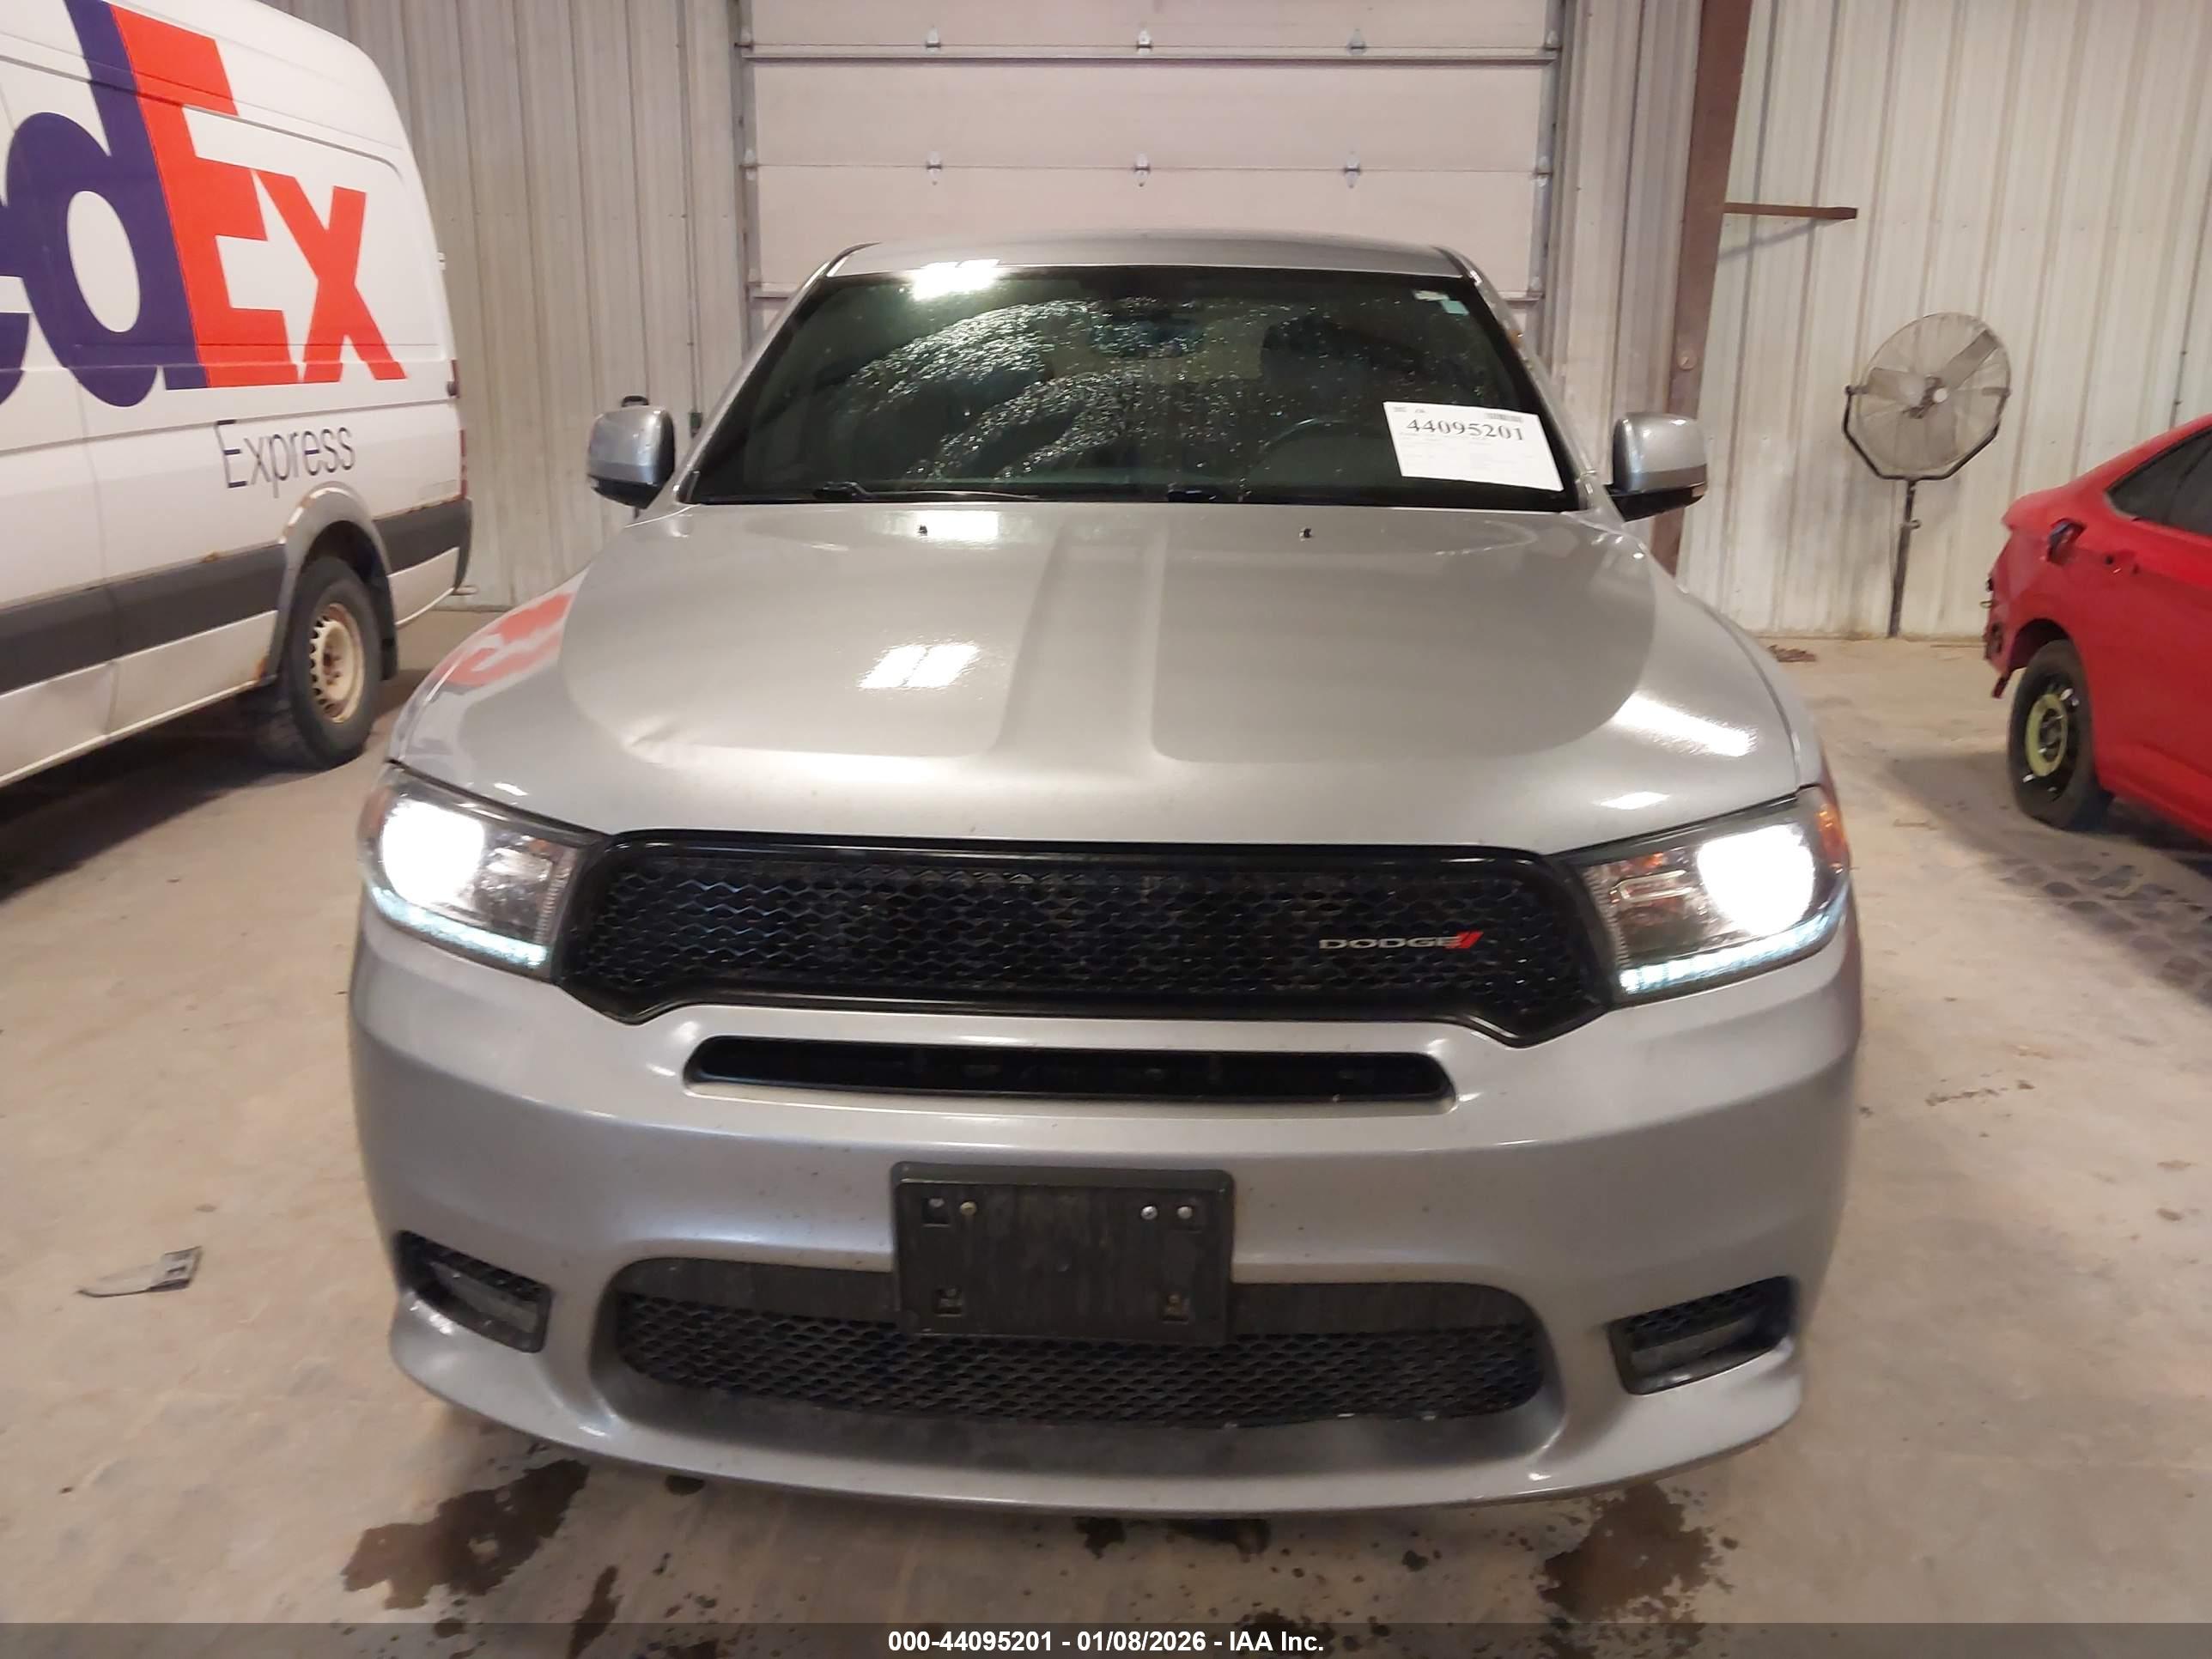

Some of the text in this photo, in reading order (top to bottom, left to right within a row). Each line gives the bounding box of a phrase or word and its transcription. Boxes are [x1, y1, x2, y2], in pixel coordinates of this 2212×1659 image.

[0, 0, 407, 407] dEx
[1407, 418, 1525, 441] 44095201
[214, 418, 356, 498] Express
[1319, 936, 1462, 950] DODGE
